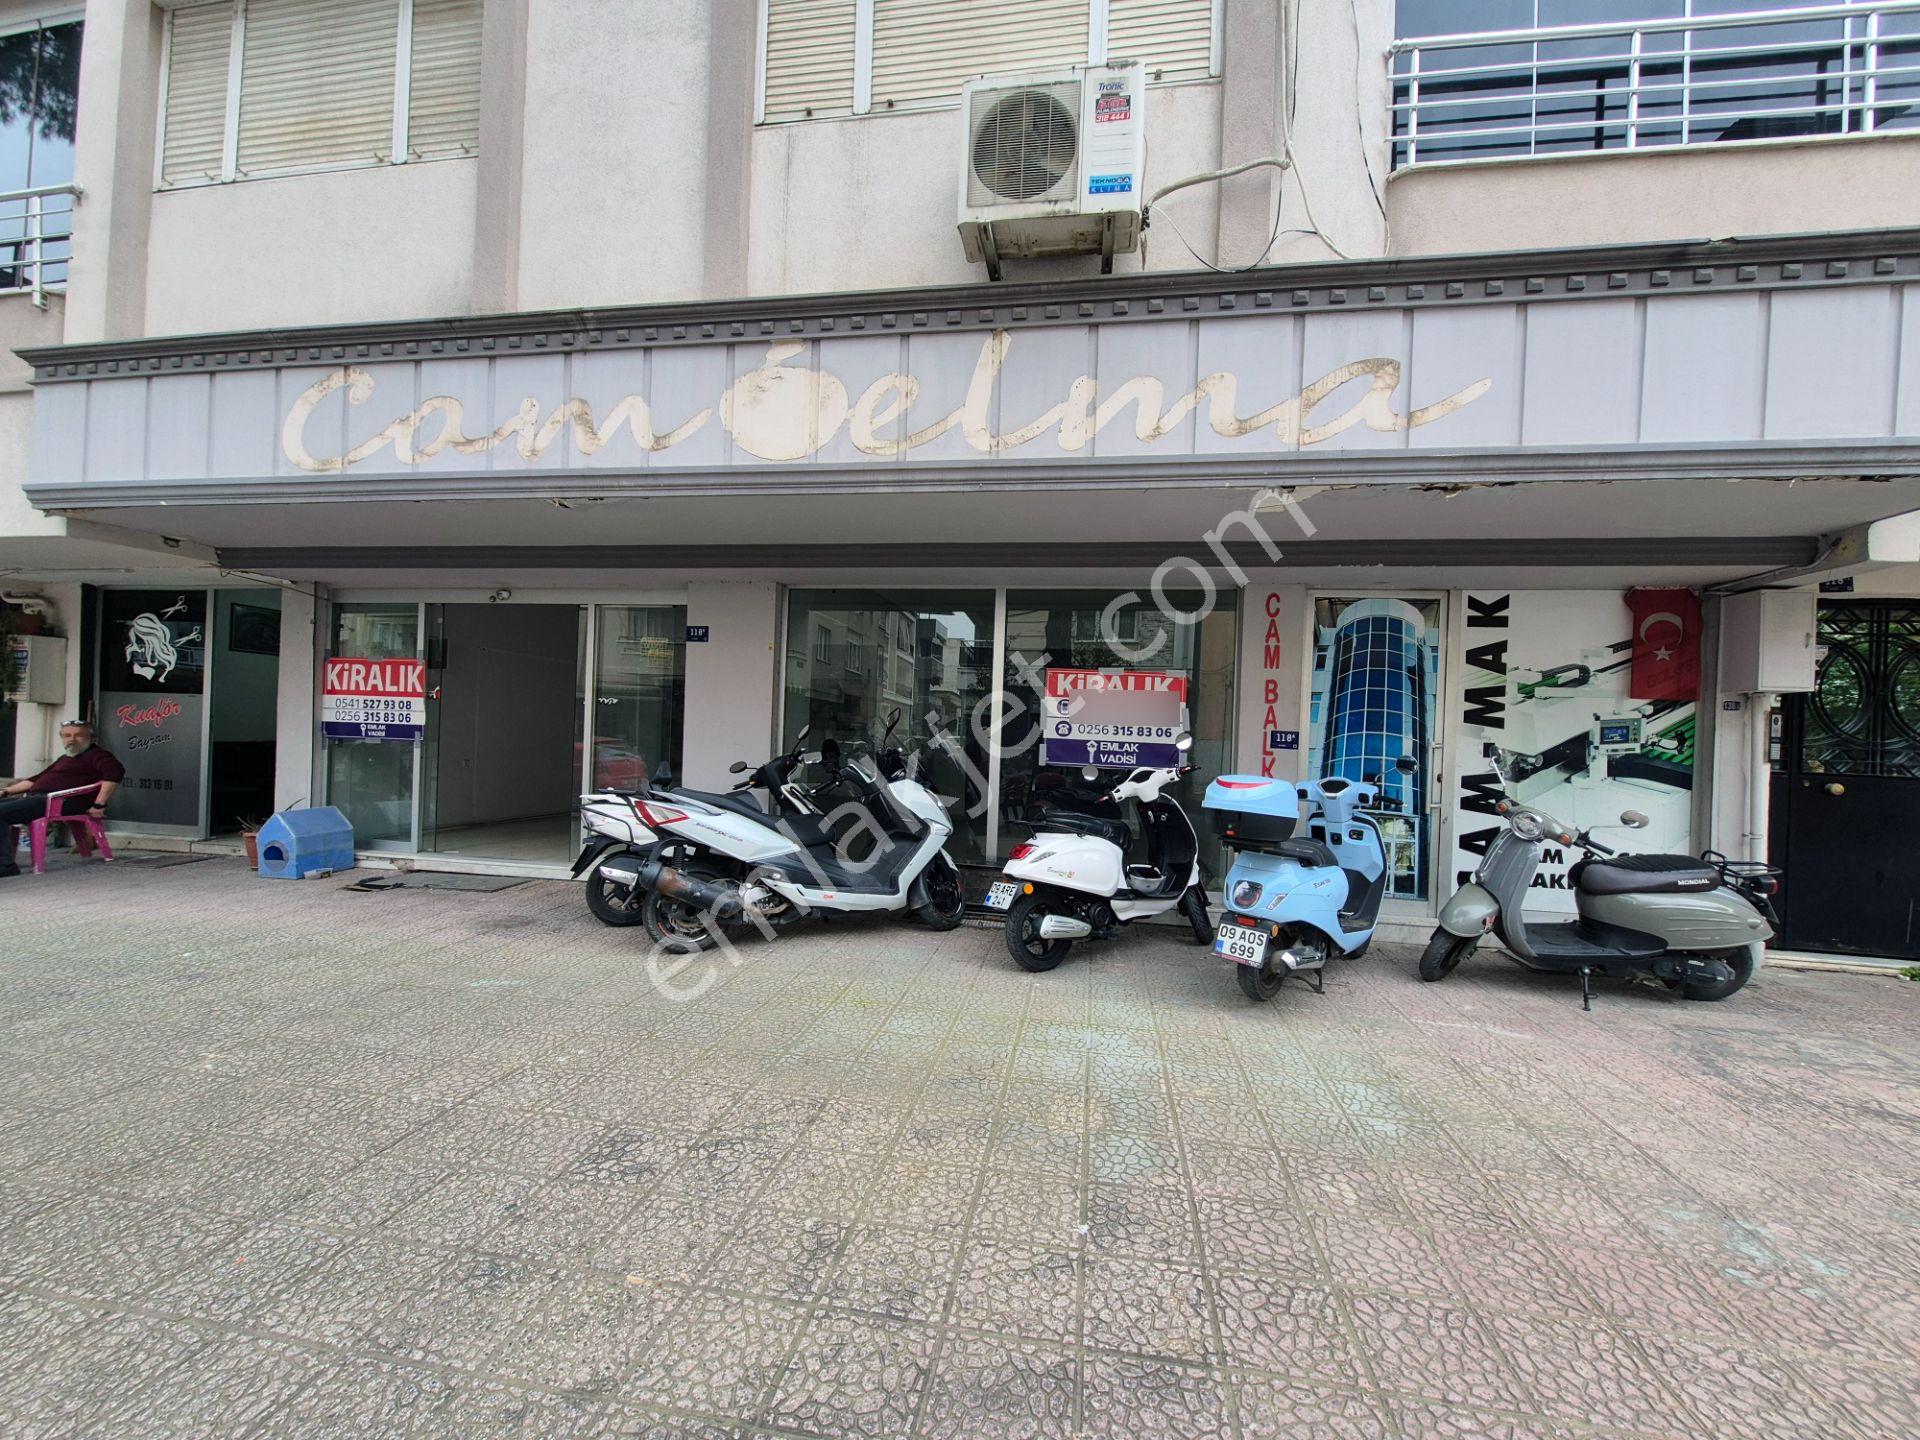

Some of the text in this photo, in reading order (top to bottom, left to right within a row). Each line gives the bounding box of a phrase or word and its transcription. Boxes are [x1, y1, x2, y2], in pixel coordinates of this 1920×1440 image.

[1264, 592, 1281, 669] CAM
[335, 698, 412, 710] 0541 527 93 08
[117, 698, 181, 728] Kuaför
[335, 711, 412, 723] 0256 315 83 06
[1078, 724, 1172, 738] 0256 315 83 06
[1100, 742, 1139, 753] EMLAK
[1100, 753, 1137, 765] VADİSİ
[1677, 878, 1710, 886] MONDIAL
[999, 885, 1016, 897] ARE
[1220, 925, 1265, 946] 09 AOS
[1229, 942, 1255, 959] 699
